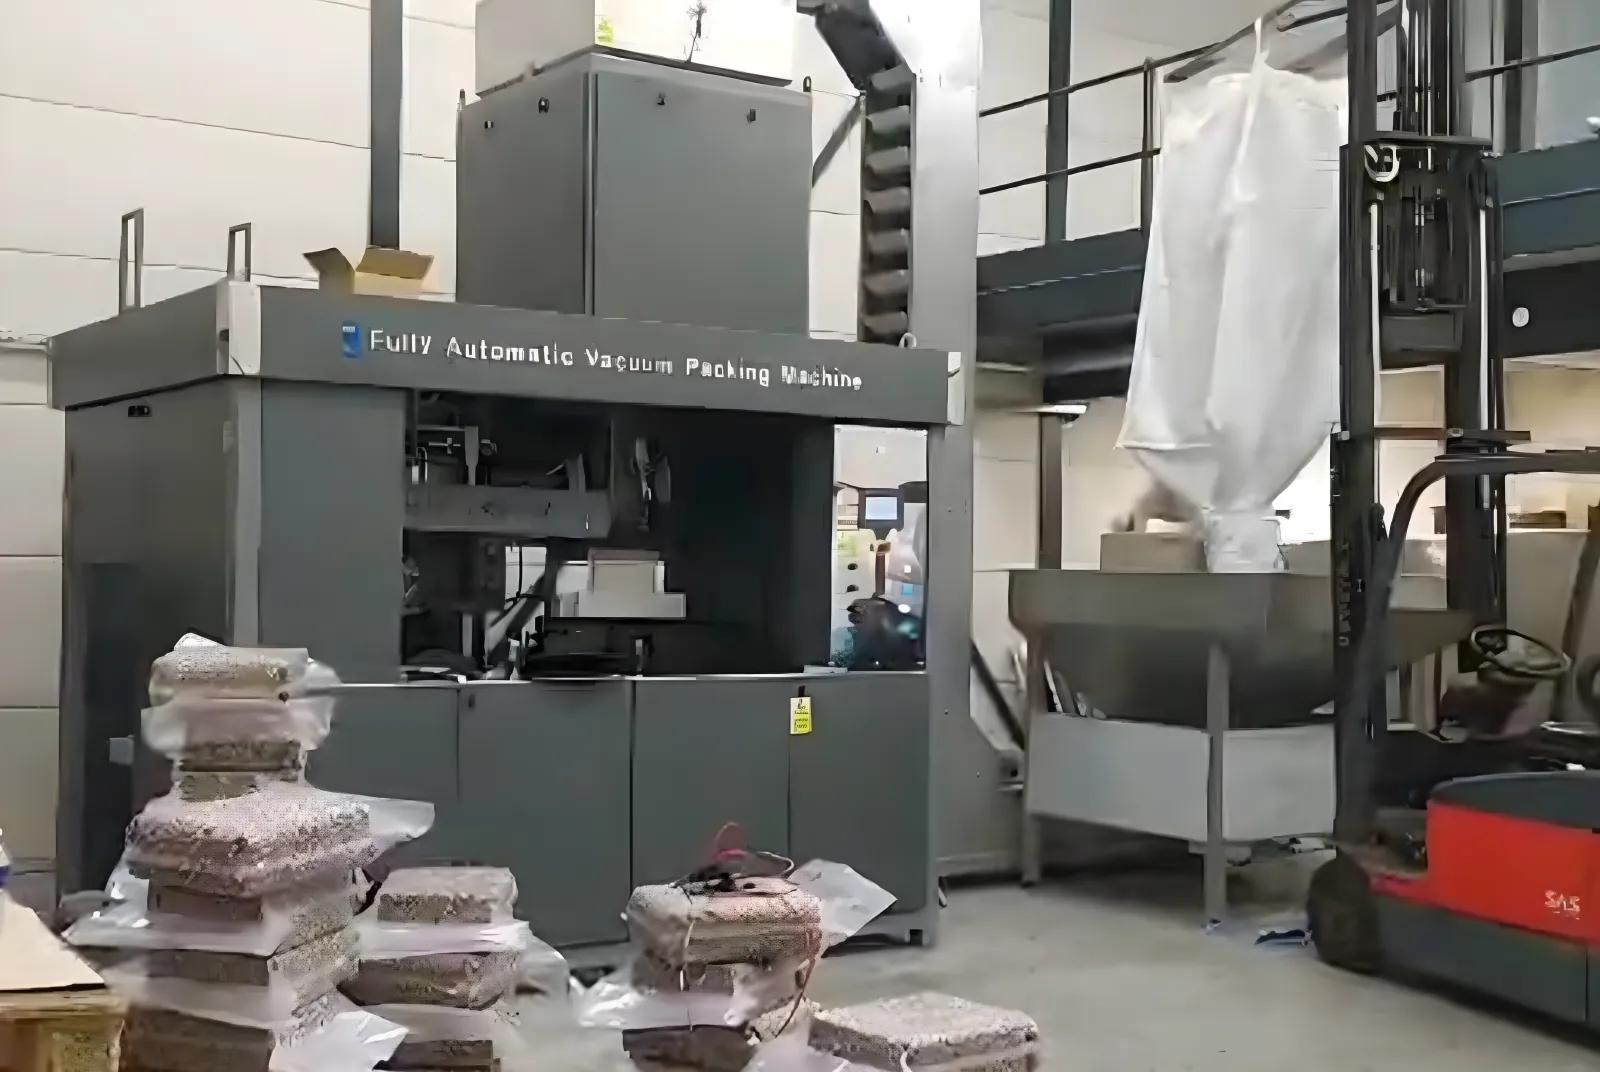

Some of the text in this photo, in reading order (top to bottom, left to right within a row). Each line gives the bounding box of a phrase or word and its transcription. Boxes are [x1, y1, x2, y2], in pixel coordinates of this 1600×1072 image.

[370, 328, 862, 391] Fully Automatic Vacuum Packing Machine
